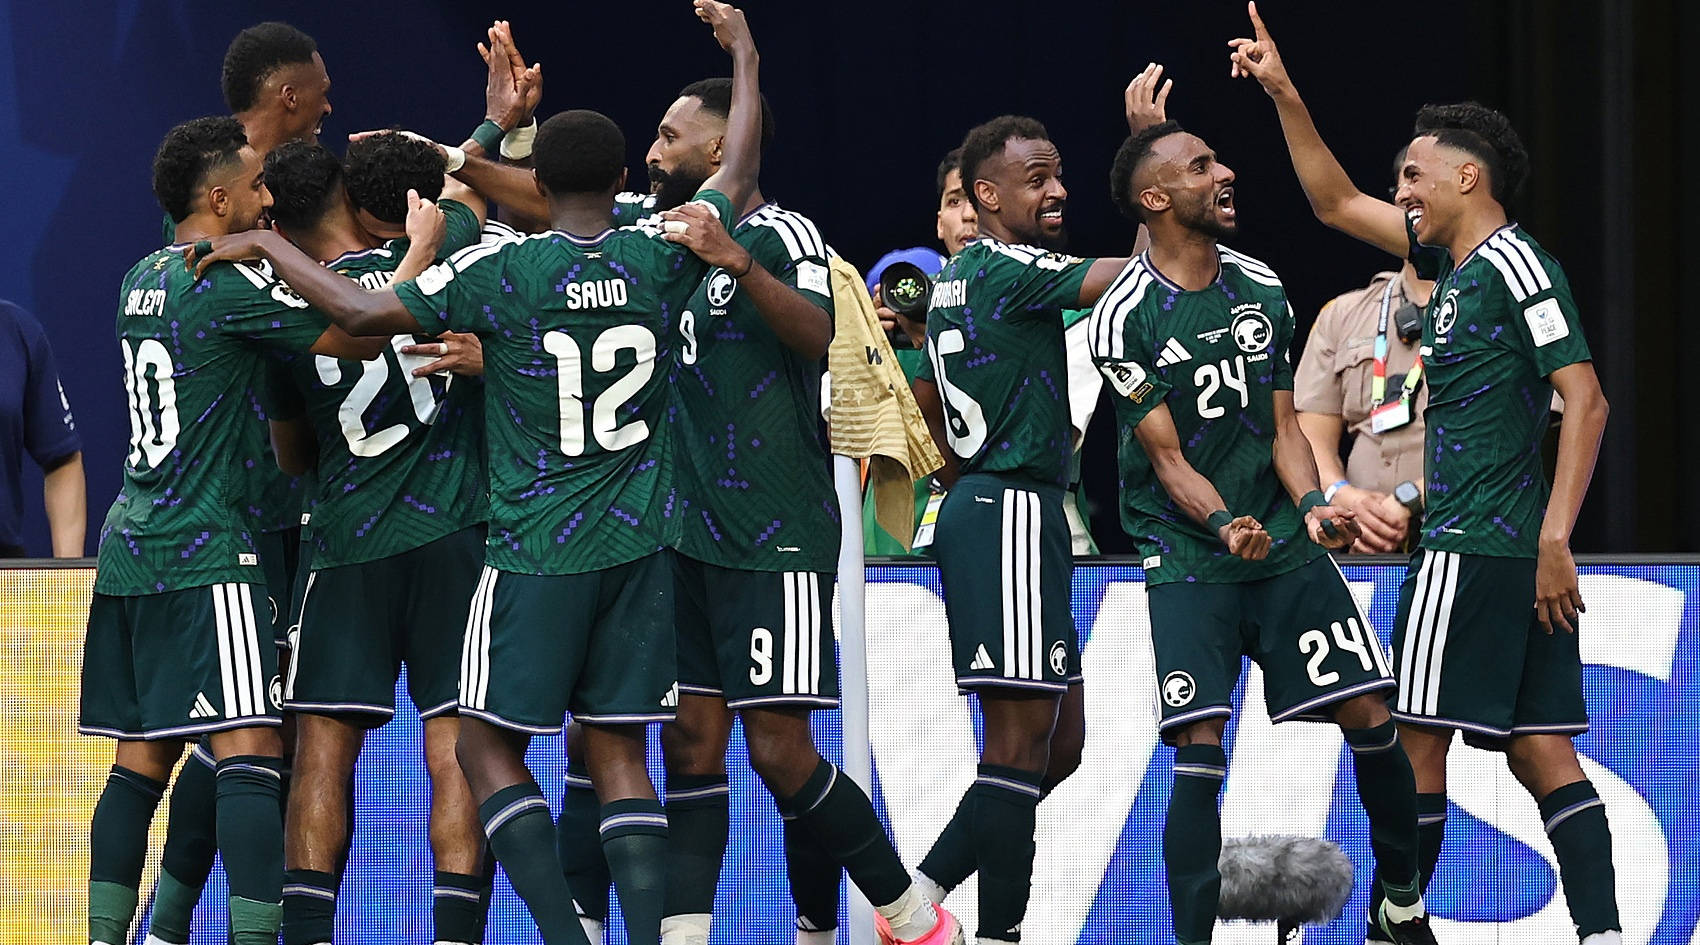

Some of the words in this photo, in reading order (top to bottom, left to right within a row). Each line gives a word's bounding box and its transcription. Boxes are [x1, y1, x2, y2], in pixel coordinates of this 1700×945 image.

[566, 278, 628, 310] SAUD
[679, 310, 698, 365] 9
[120, 338, 180, 469] 10
[542, 324, 656, 457] 12
[1193, 354, 1249, 419] 24
[749, 627, 773, 686] 9
[1298, 616, 1373, 687] 24
[834, 572, 1700, 945] VIS
